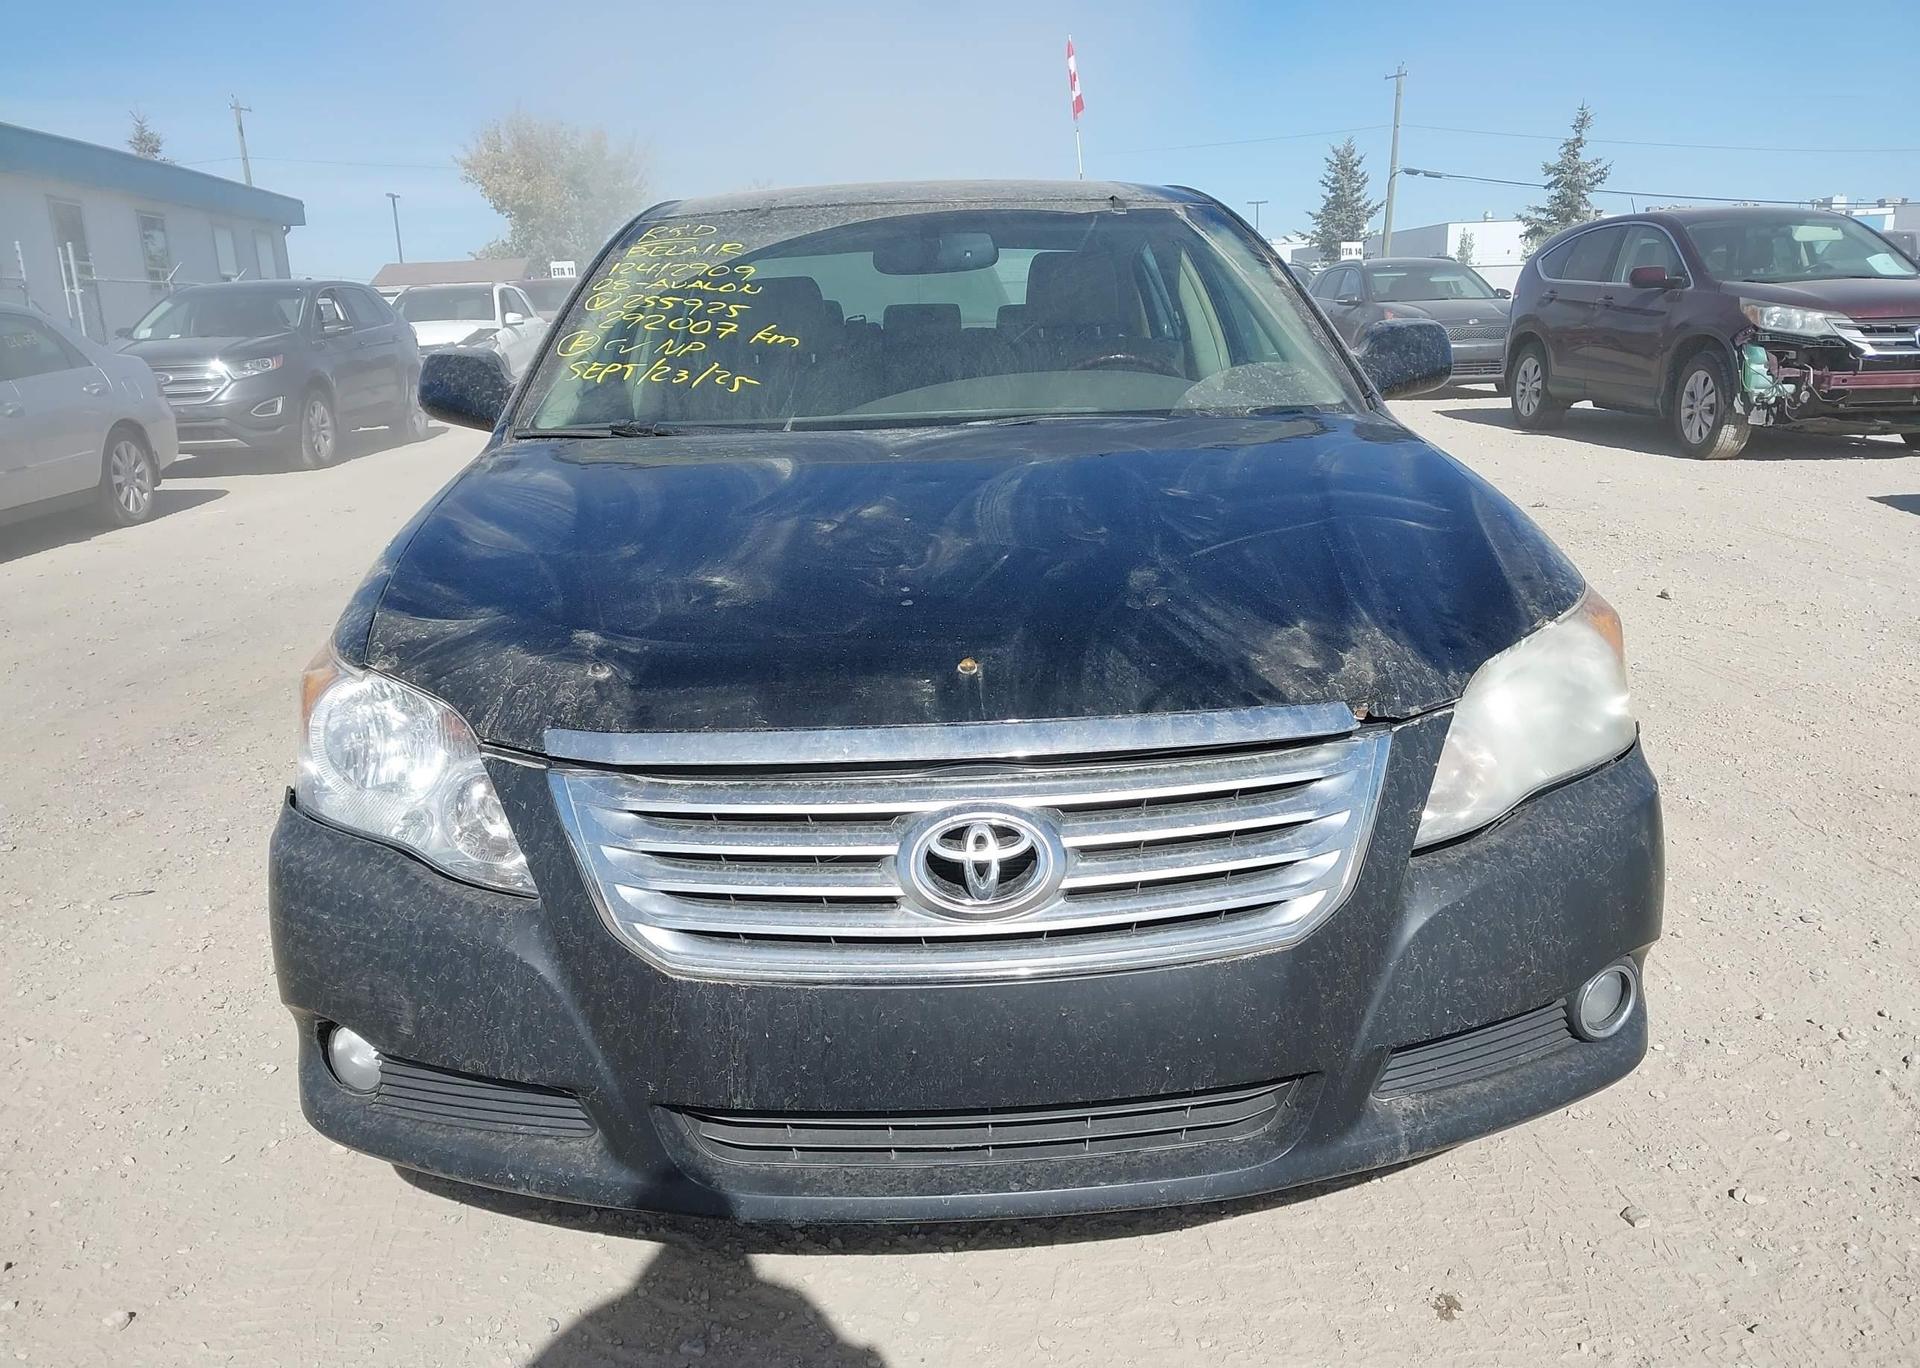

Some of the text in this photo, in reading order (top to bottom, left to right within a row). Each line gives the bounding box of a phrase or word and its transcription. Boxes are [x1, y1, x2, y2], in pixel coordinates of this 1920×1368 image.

[626, 243, 744, 257] BELAIR
[1342, 247, 1362, 256] ETA 14
[552, 267, 574, 276] ETA 11
[623, 294, 752, 318] 255925
[599, 311, 738, 339] 292007
